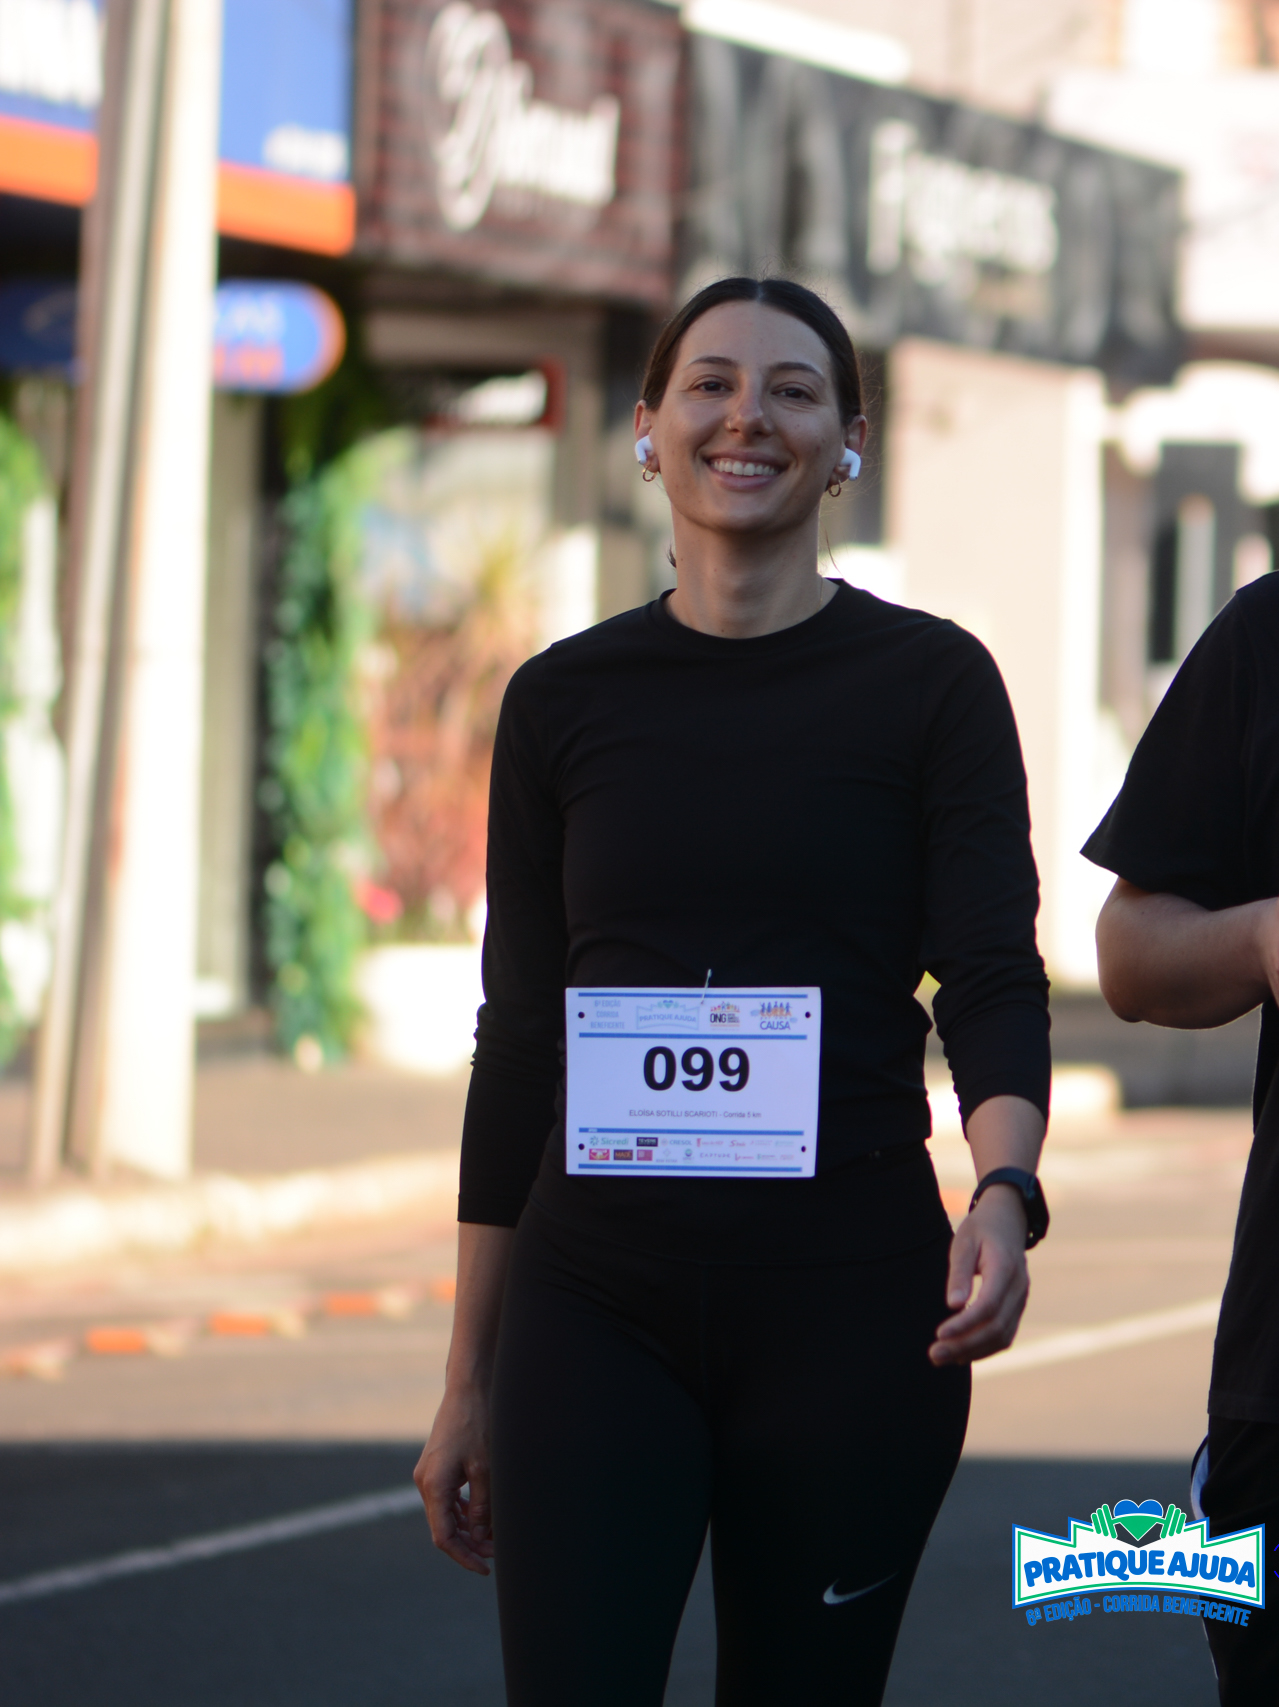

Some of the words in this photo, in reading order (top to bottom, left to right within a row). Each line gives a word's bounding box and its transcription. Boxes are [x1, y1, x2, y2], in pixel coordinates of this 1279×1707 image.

[710, 1013, 726, 1023] ONG
[760, 1021, 791, 1030] CAUSA
[643, 1046, 750, 1092] 099
